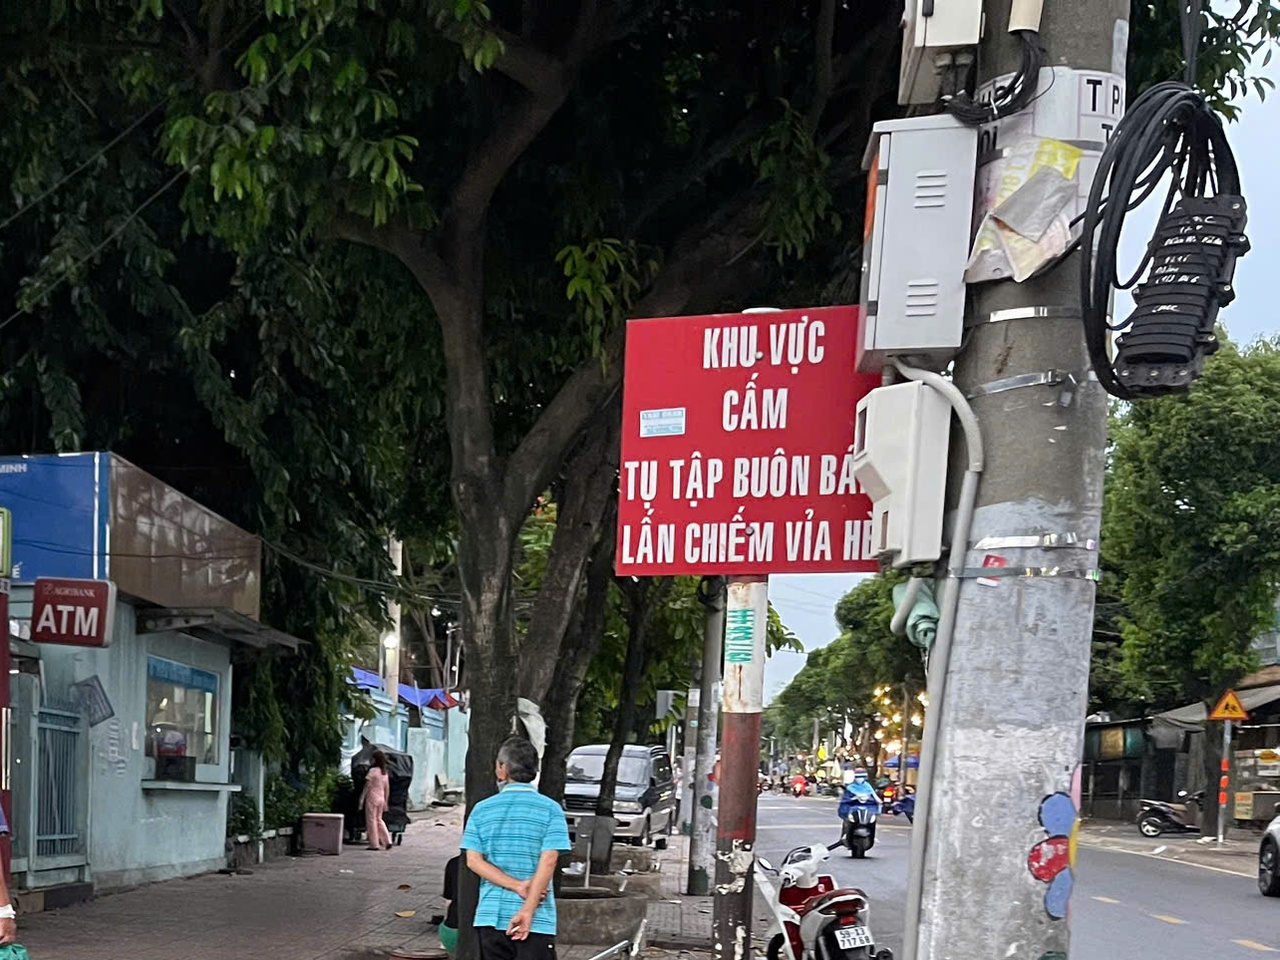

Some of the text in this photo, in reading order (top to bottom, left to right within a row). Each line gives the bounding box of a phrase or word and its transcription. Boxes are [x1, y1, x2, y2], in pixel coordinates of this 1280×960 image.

[703, 316, 826, 374] KHU VỰC
[722, 372, 788, 432] CẤM
[624, 444, 867, 509] TỤ TẬP BUÔN BÁ
[622, 508, 675, 564] LẤN
[684, 506, 774, 564] CHIẾM
[785, 509, 833, 562] VỈA
[35, 604, 100, 637] ATM
